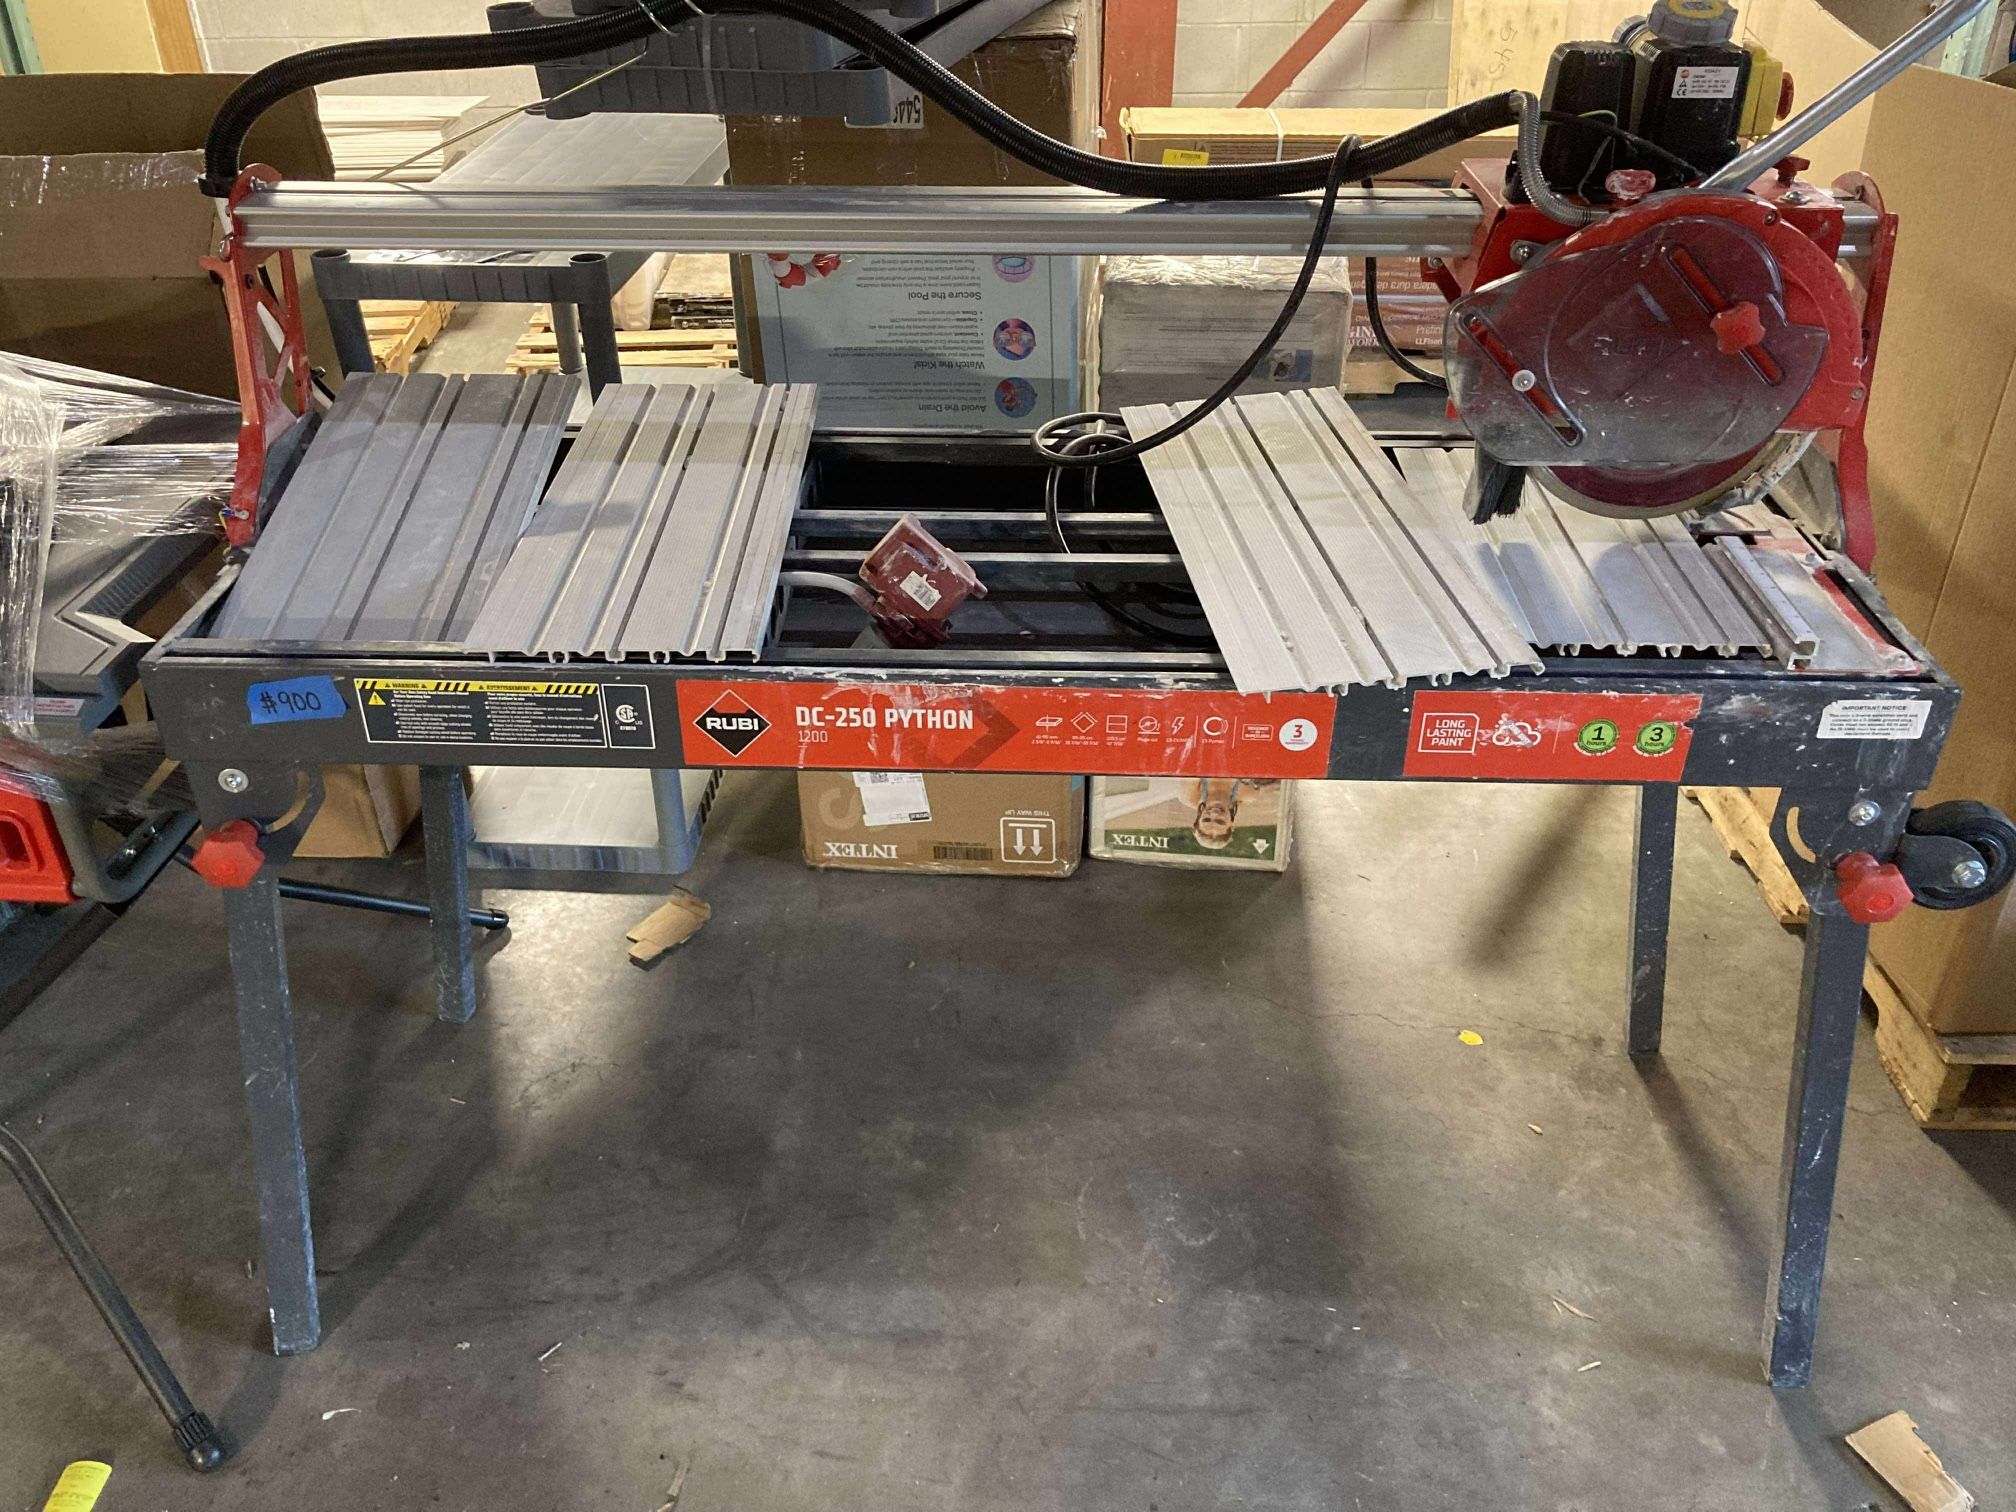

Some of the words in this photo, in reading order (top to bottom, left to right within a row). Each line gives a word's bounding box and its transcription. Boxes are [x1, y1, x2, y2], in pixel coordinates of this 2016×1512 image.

[908, 291, 929, 301] Pool
[931, 291, 947, 301] the
[949, 291, 982, 301] Secure
[1415, 324, 1441, 335] Prefin
[913, 360, 938, 370] Kids!
[939, 360, 954, 370] the
[956, 360, 985, 370] Watch
[918, 403, 943, 413] Drain
[945, 403, 960, 413] the
[961, 402, 987, 413] Avoid
[259, 691, 321, 714] #900
[796, 706, 876, 728] DC-250
[885, 708, 973, 730] PYTHON
[705, 717, 760, 731] RUBI
[1435, 719, 1465, 728] LONG
[1293, 724, 1303, 738] 3
[1426, 728, 1472, 738] LASTING
[1591, 726, 1605, 741] 1
[1649, 727, 1664, 742] 3
[797, 730, 828, 743] 1200
[1430, 737, 1465, 746] PAINT
[1033, 809, 1050, 817] THIS
[1111, 833, 1170, 849] INTEX
[823, 841, 899, 860] INTEX
